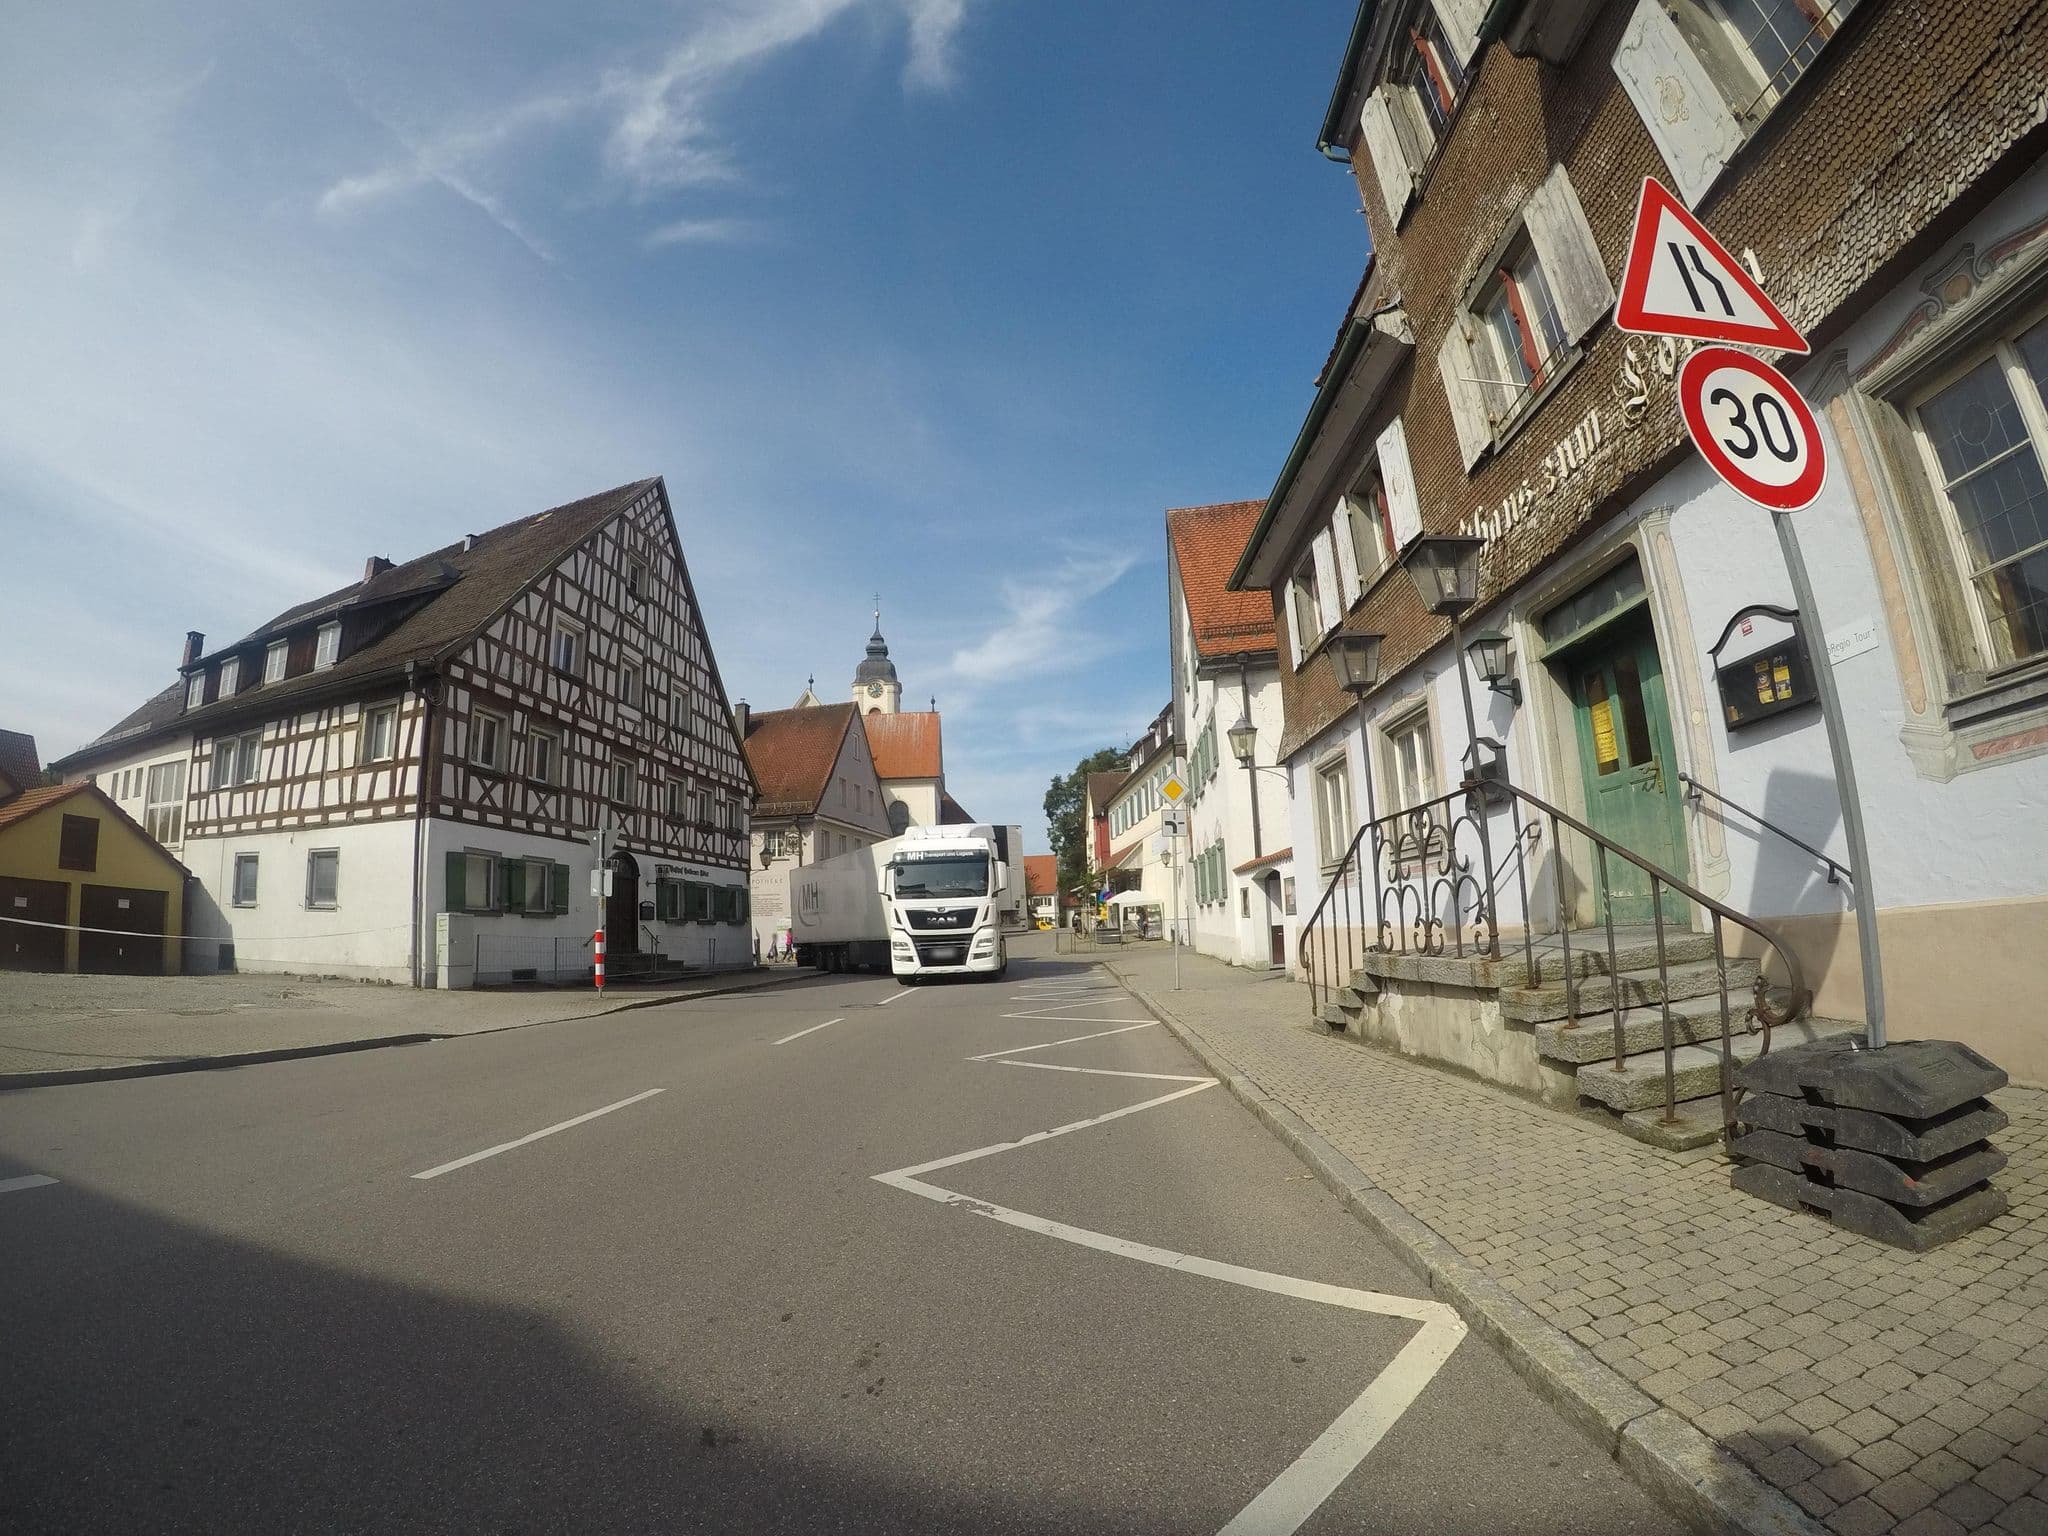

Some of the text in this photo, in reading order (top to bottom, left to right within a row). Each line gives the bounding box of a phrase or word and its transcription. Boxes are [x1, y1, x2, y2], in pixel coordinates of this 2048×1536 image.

[1710, 388, 1798, 462] 30
[1545, 408, 1600, 494] zum
[1852, 631, 1871, 642] Tour
[907, 851, 924, 861] MH
[802, 881, 819, 911] MH
